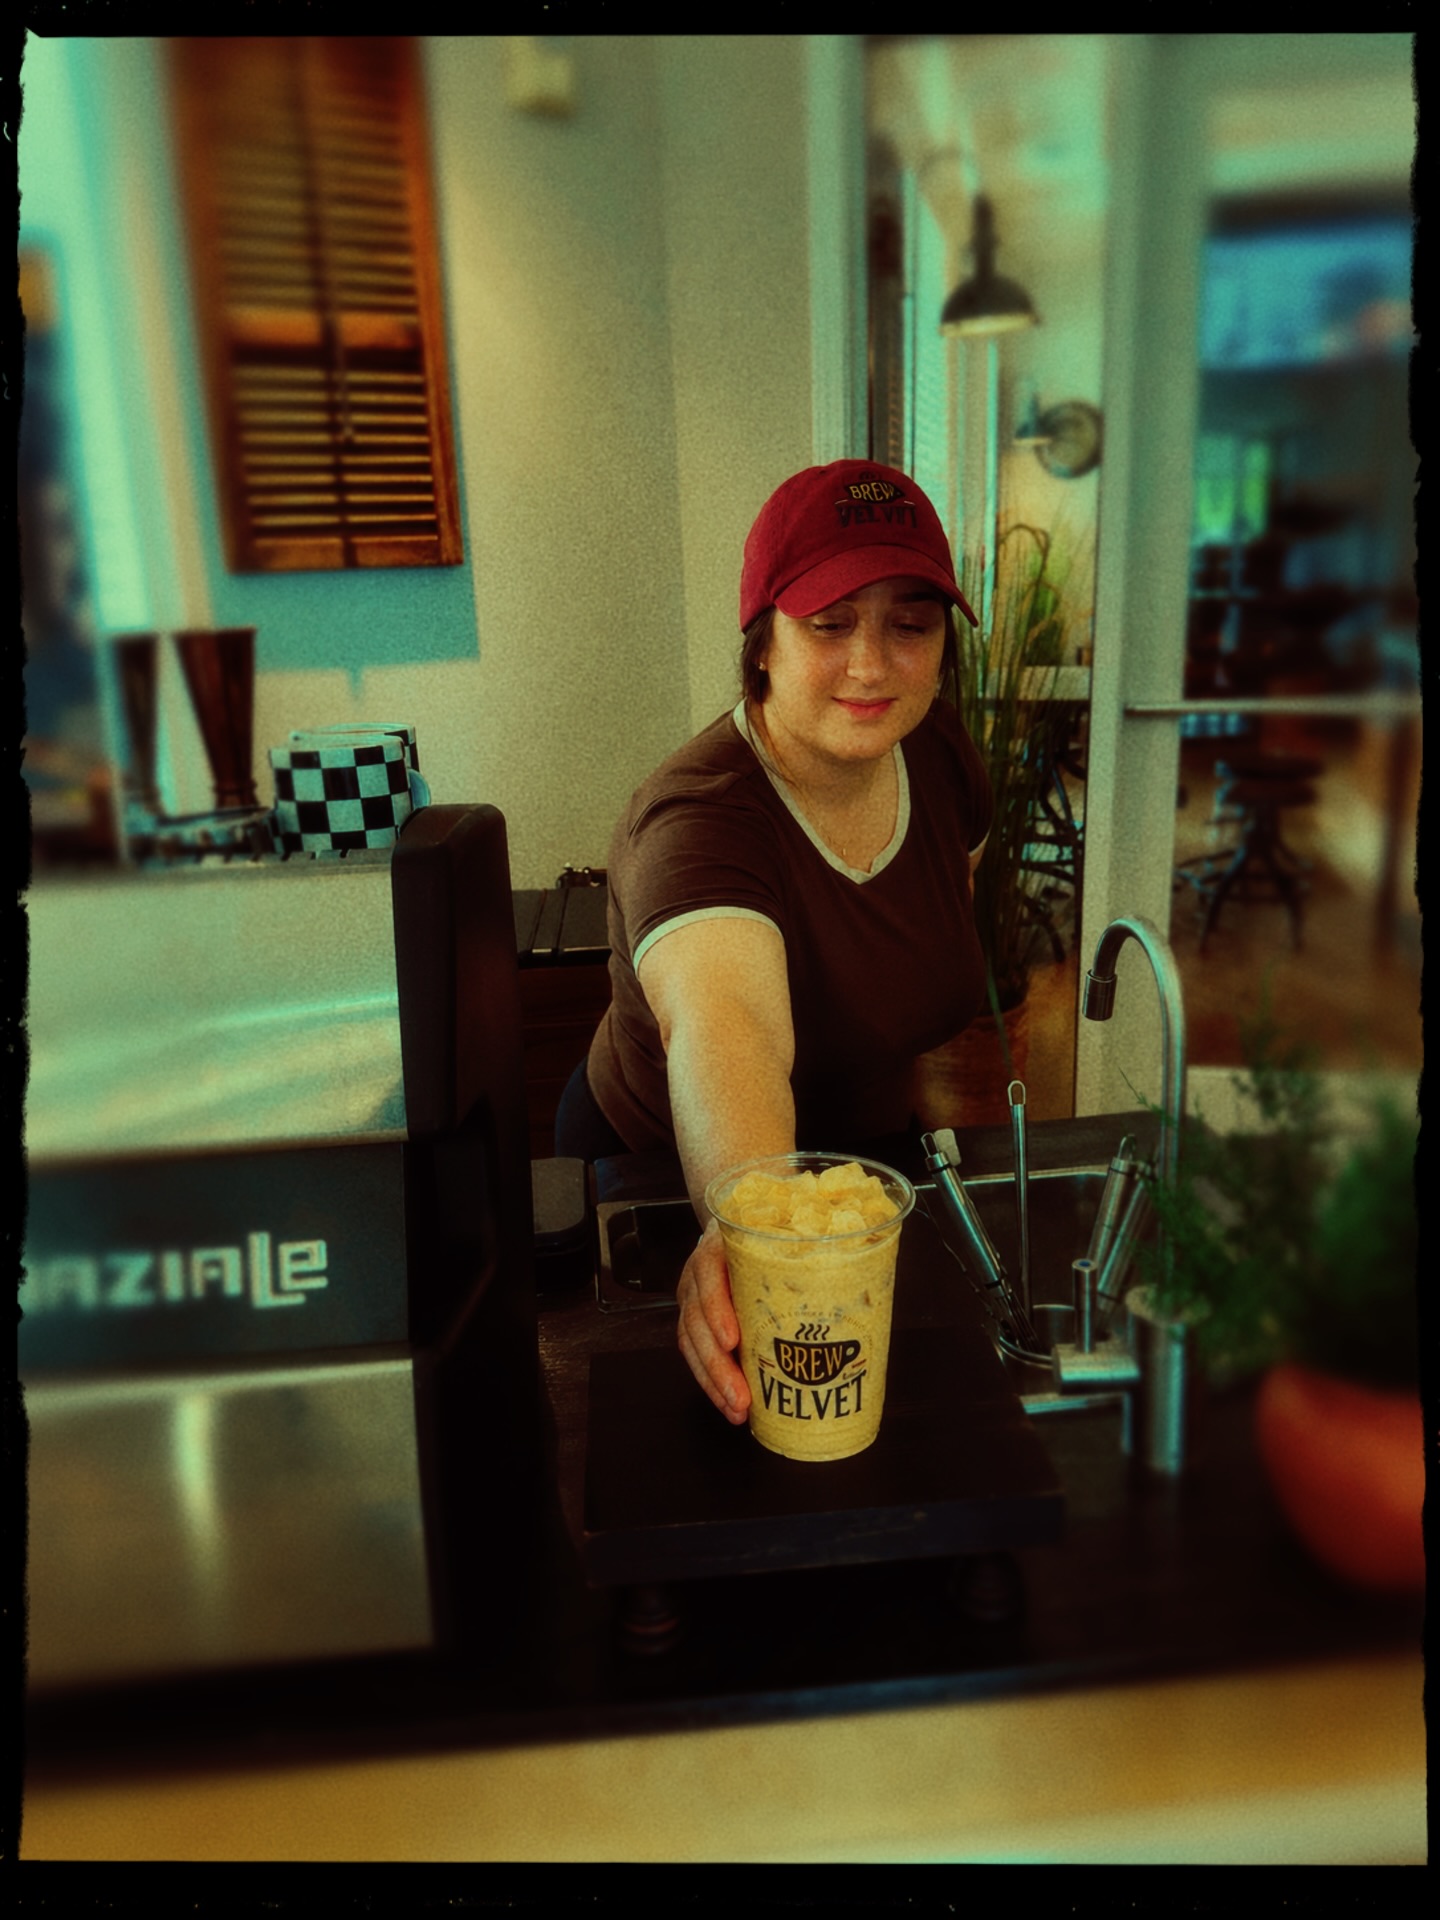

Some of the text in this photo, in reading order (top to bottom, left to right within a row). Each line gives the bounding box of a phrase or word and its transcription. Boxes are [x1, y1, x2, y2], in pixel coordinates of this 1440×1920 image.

[848, 482, 895, 502] BREW
[779, 1342, 843, 1382] BREW
[758, 1365, 867, 1421] VELVET
